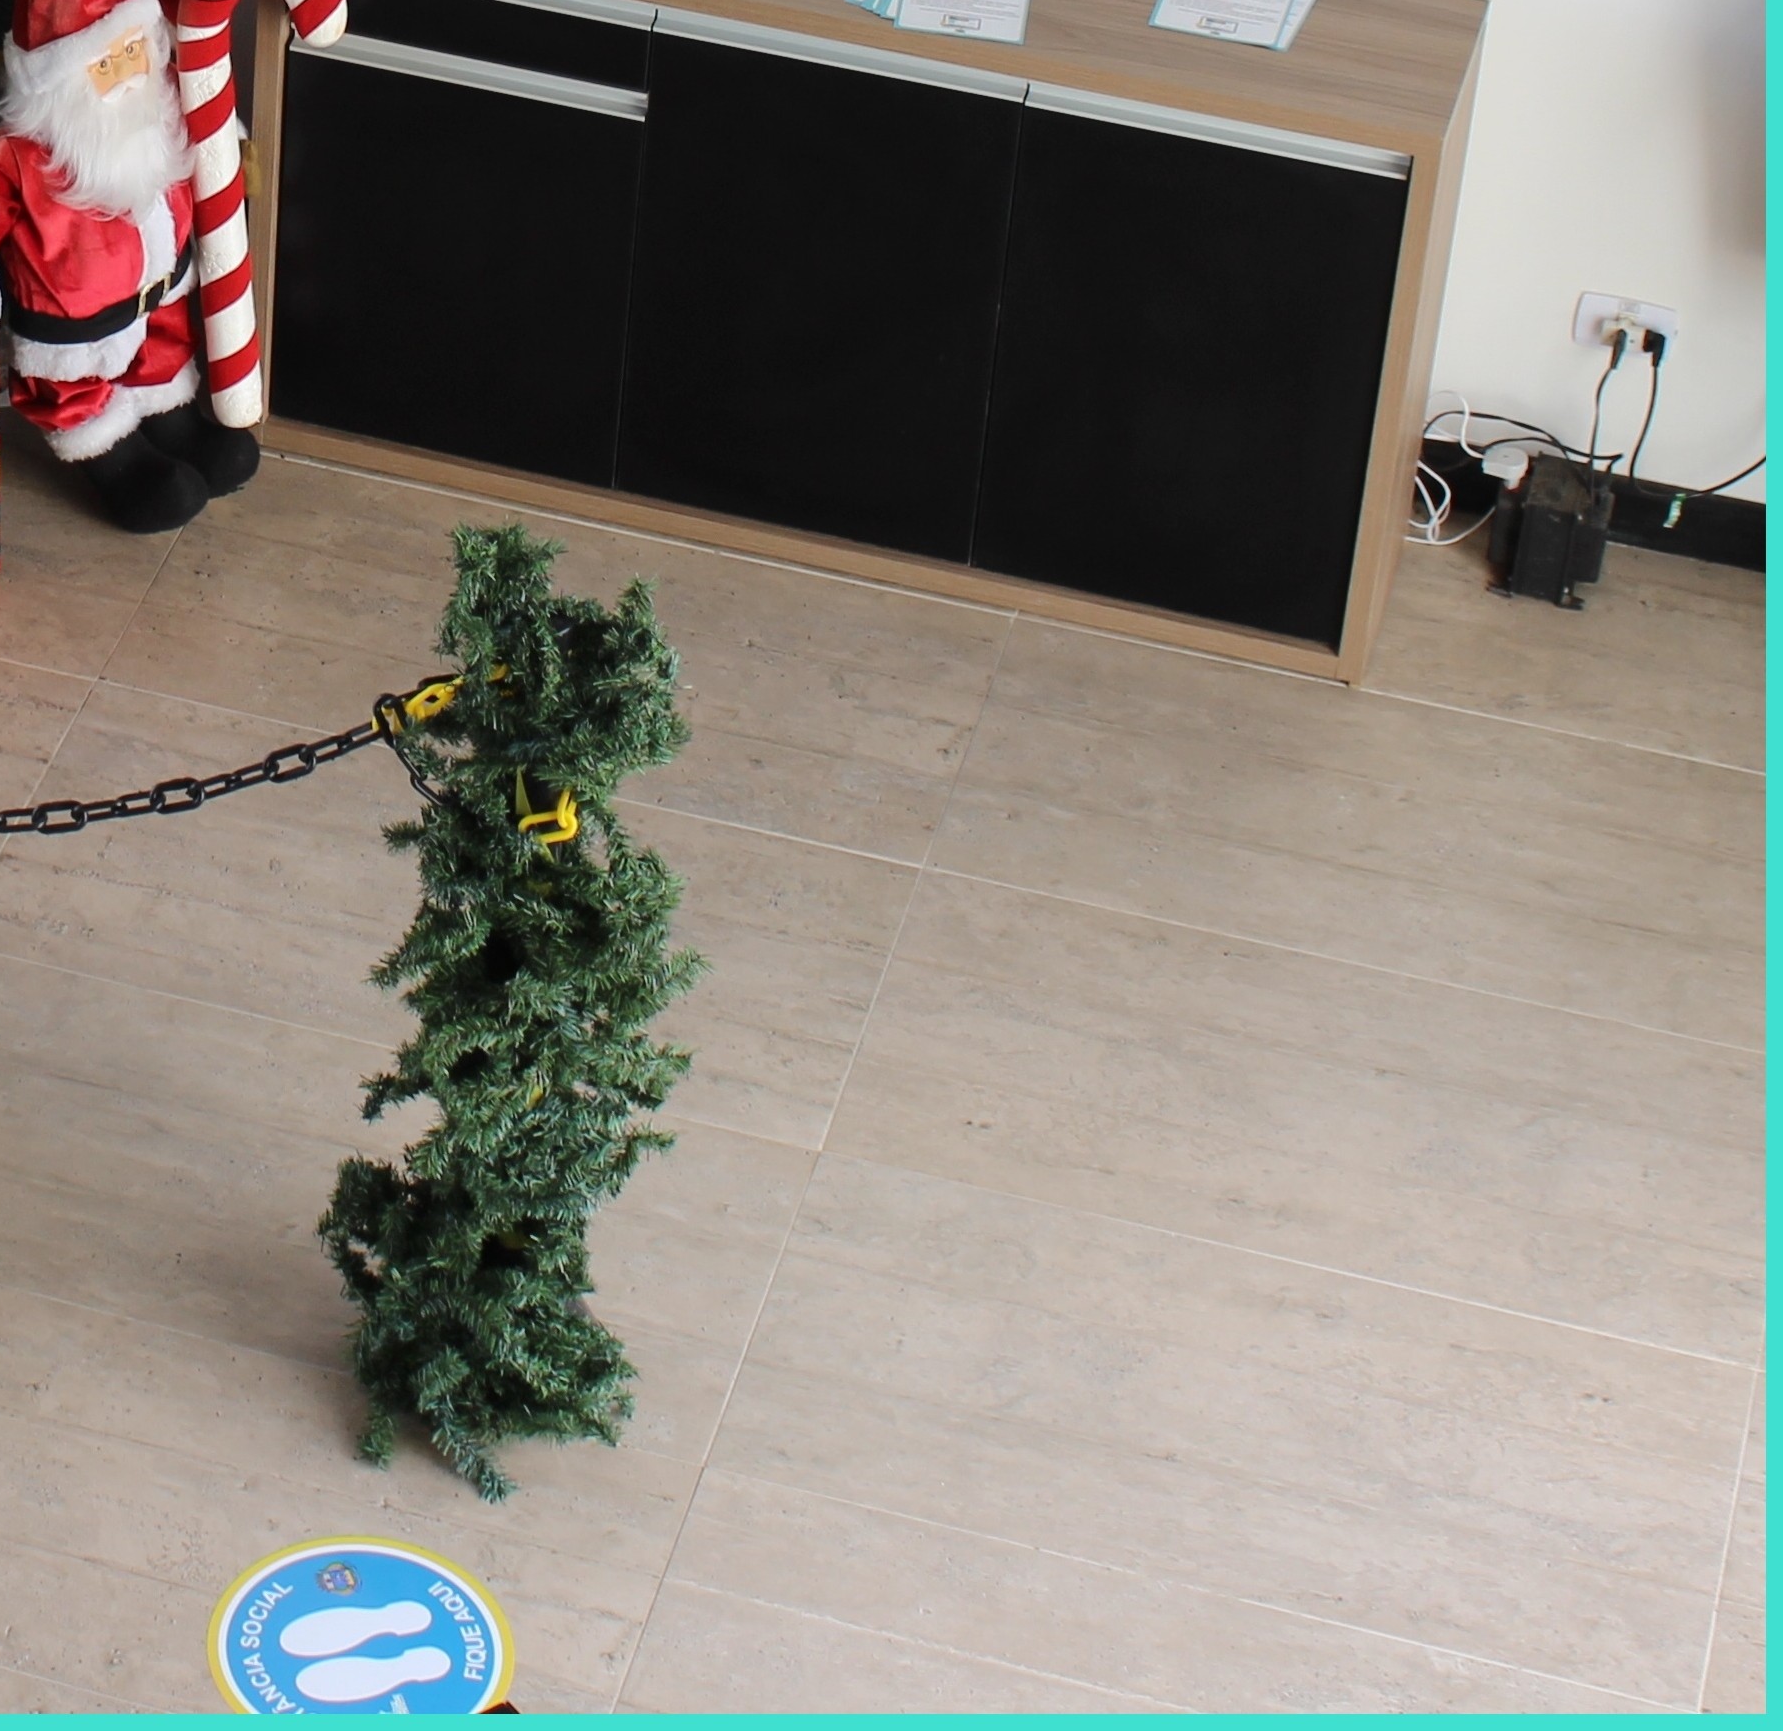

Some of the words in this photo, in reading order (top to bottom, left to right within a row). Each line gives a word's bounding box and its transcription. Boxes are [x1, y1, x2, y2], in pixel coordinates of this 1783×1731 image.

[240, 1581, 293, 1649] SOCIAL
[427, 1580, 476, 1624] AQUI
[460, 1624, 487, 1681] FIQUE
